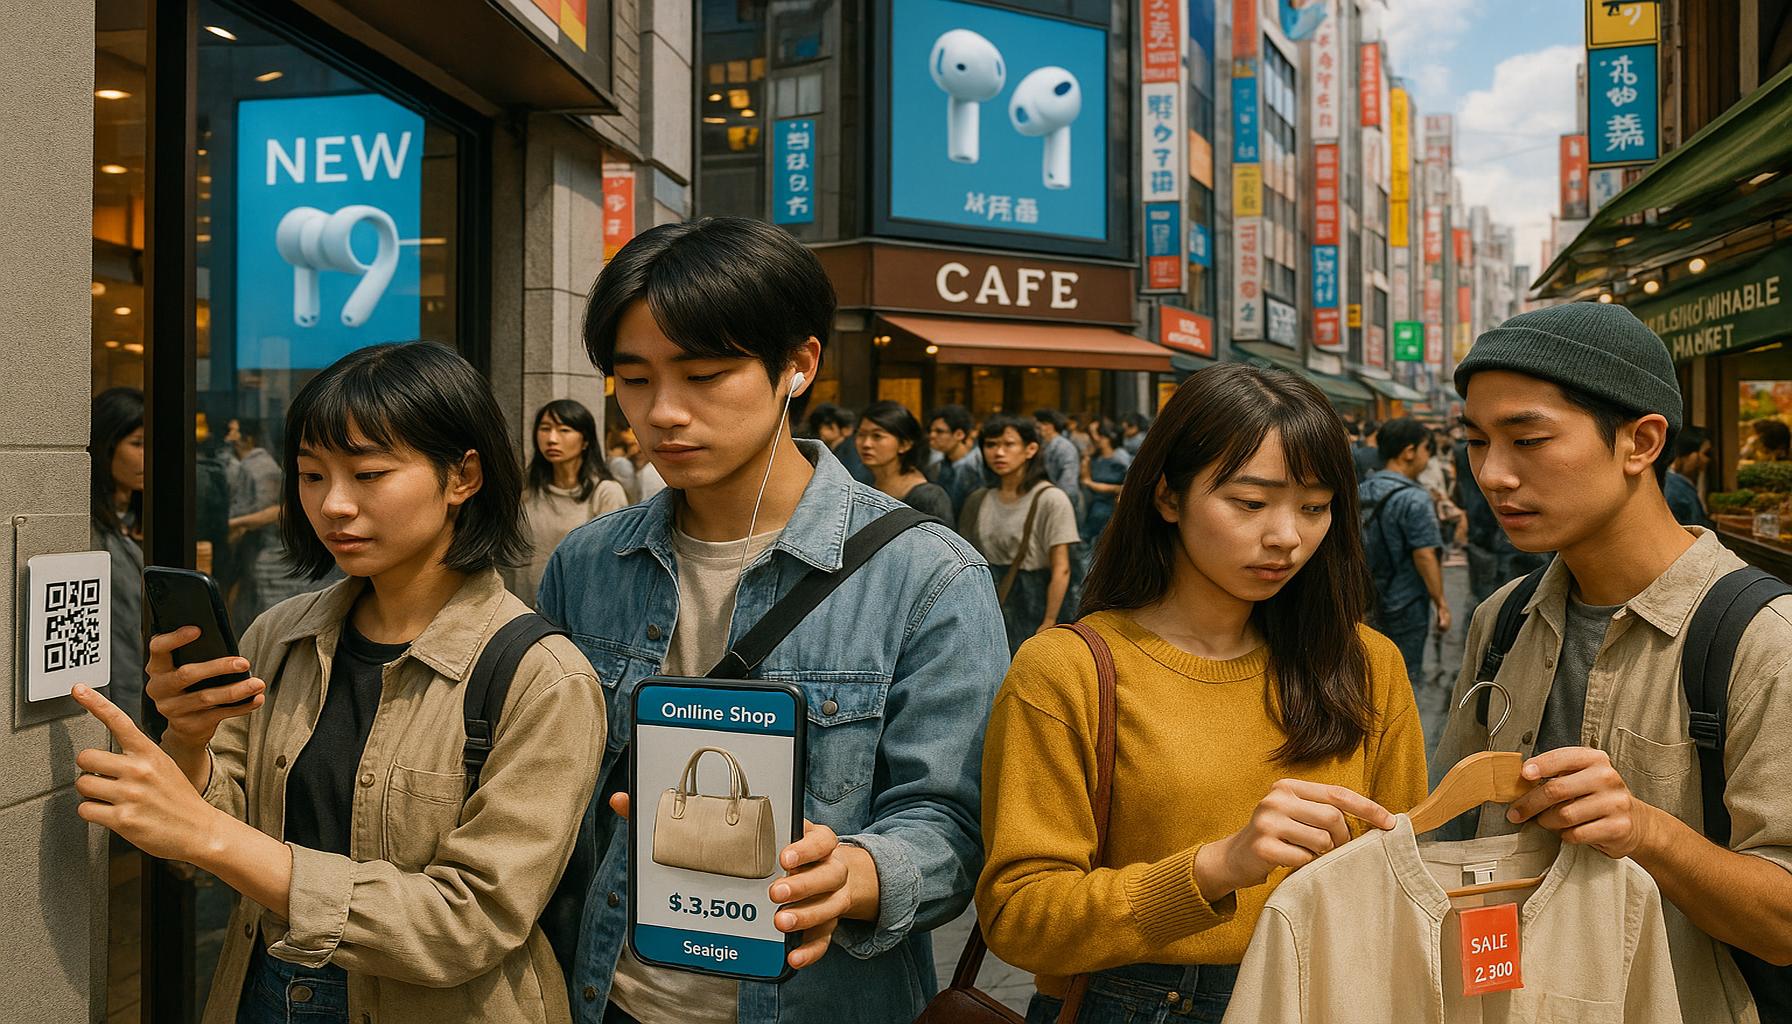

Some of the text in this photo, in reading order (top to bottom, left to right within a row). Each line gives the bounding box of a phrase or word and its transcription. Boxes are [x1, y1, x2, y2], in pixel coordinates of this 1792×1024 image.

[265, 131, 412, 186] NEW
[936, 261, 1080, 310] CAFE
[730, 706, 776, 728] Shop
[668, 892, 757, 922] $.3,500
[683, 940, 738, 962] Seaigie
[1471, 933, 1508, 954] SALE
